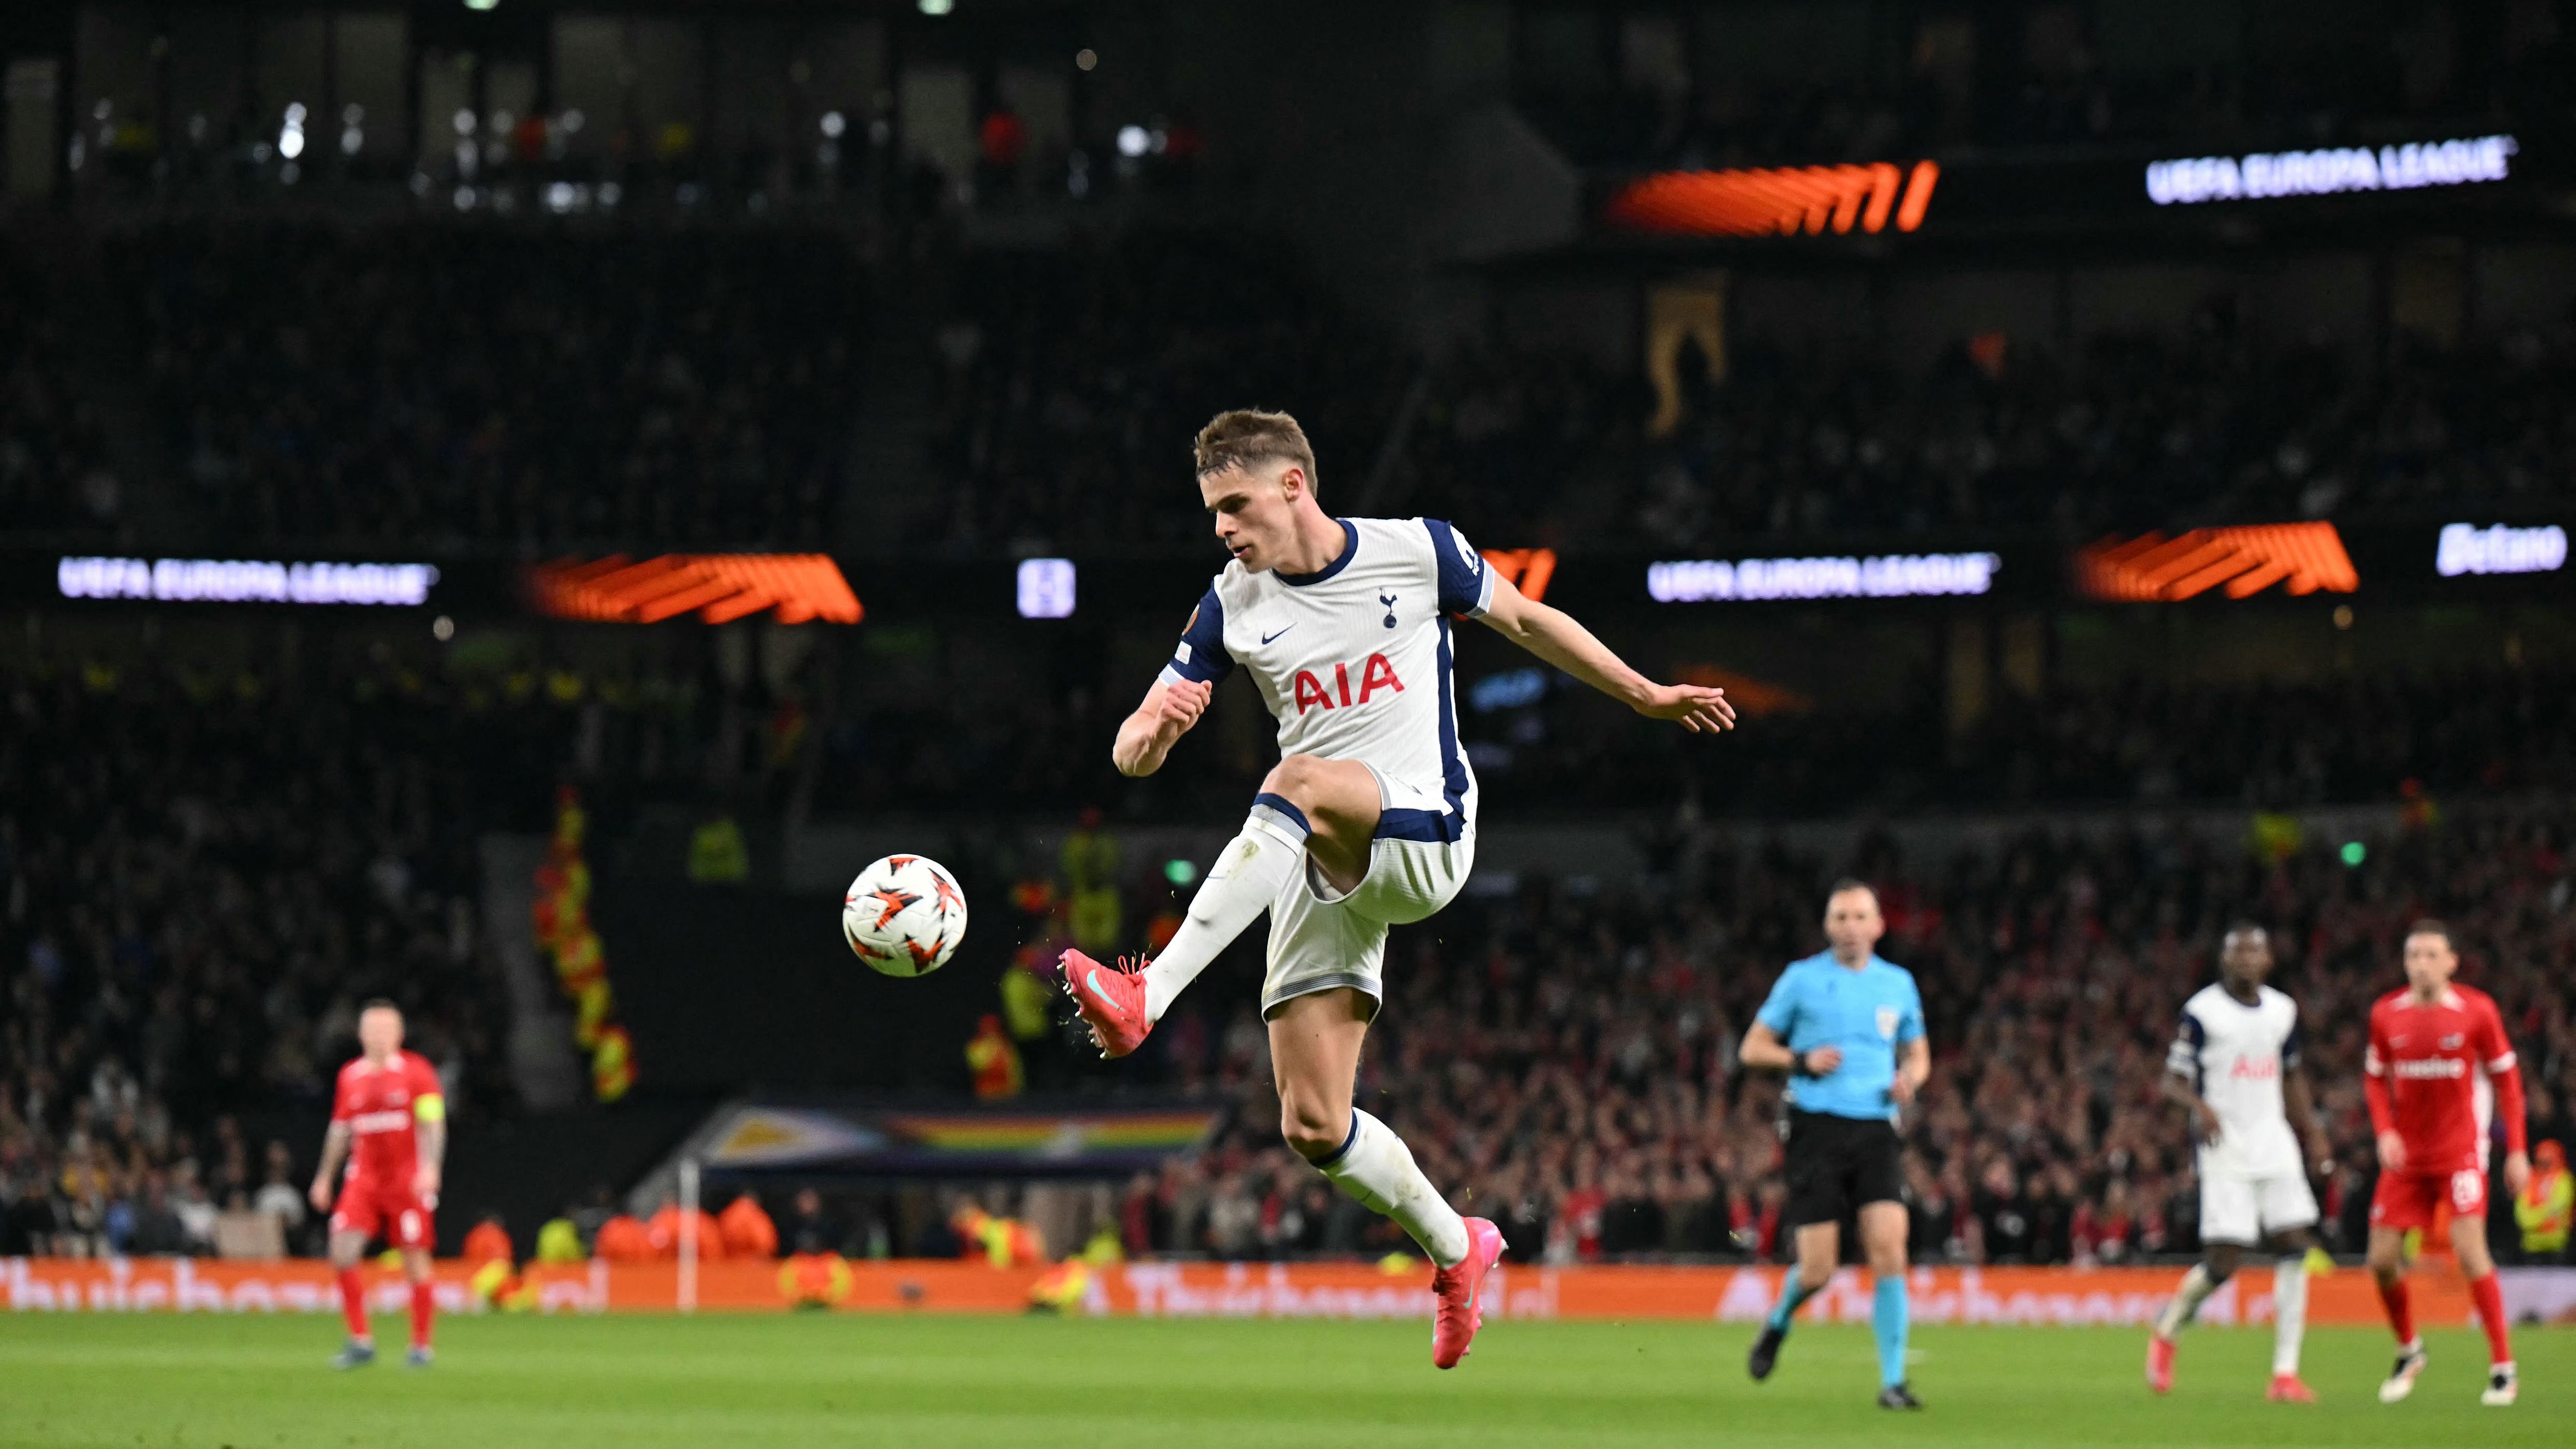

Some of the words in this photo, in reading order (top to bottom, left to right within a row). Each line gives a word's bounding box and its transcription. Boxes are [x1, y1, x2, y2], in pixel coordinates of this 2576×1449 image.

[2147, 156, 2241, 205] UEFA
[2241, 146, 2379, 199] EUROPA
[2379, 135, 2512, 189] LEAGUE
[58, 556, 151, 599] UEFA
[153, 558, 288, 602] EUROPA
[288, 562, 430, 605] LEAGUE
[1647, 559, 1735, 603] UEFA
[1736, 556, 1861, 600] EUROPA
[1862, 552, 1994, 597] LEAGUE
[1294, 652, 1405, 715] AIA
